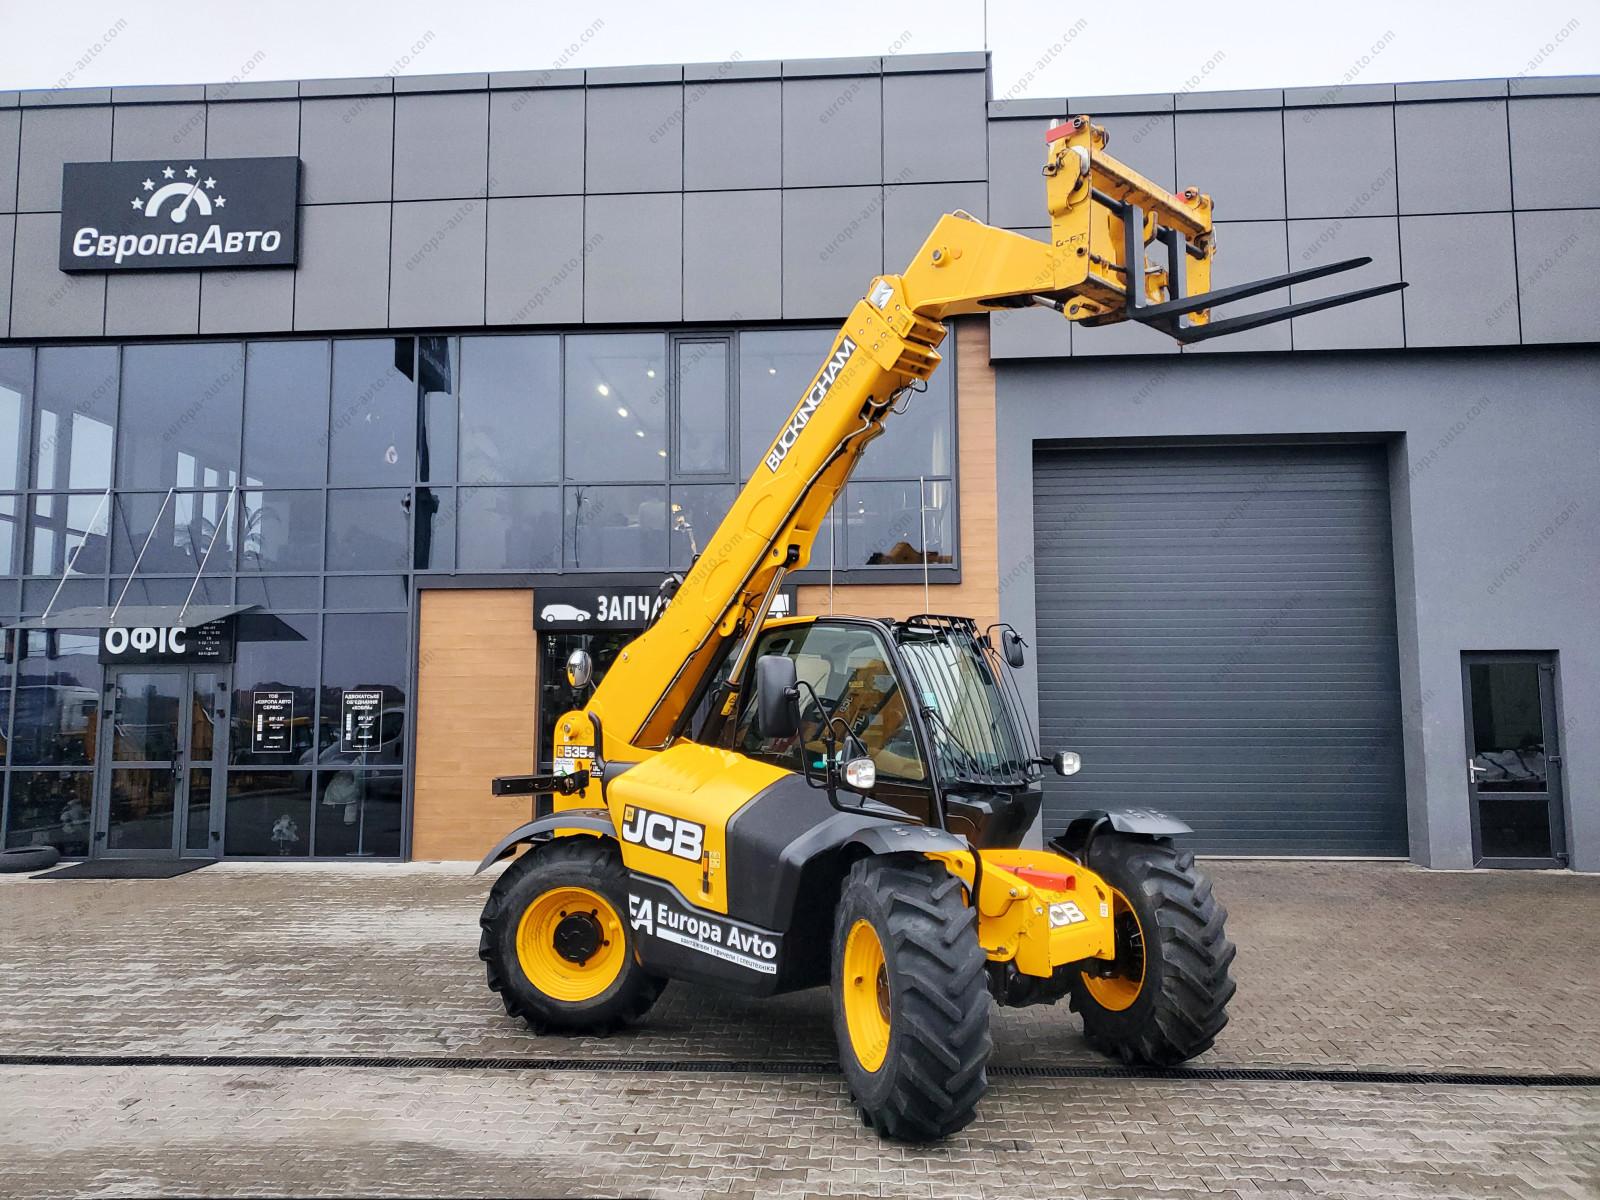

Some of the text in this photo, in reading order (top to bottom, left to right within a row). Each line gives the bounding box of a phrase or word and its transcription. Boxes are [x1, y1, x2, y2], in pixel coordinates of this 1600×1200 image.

[73, 225, 281, 264] ЄвропаАвто
[766, 338, 856, 473] BUCKINGHAM
[105, 627, 186, 654] ОФІС
[622, 810, 702, 861] JCB
[657, 903, 777, 959] Europa Avto
[1050, 902, 1086, 928] CB
